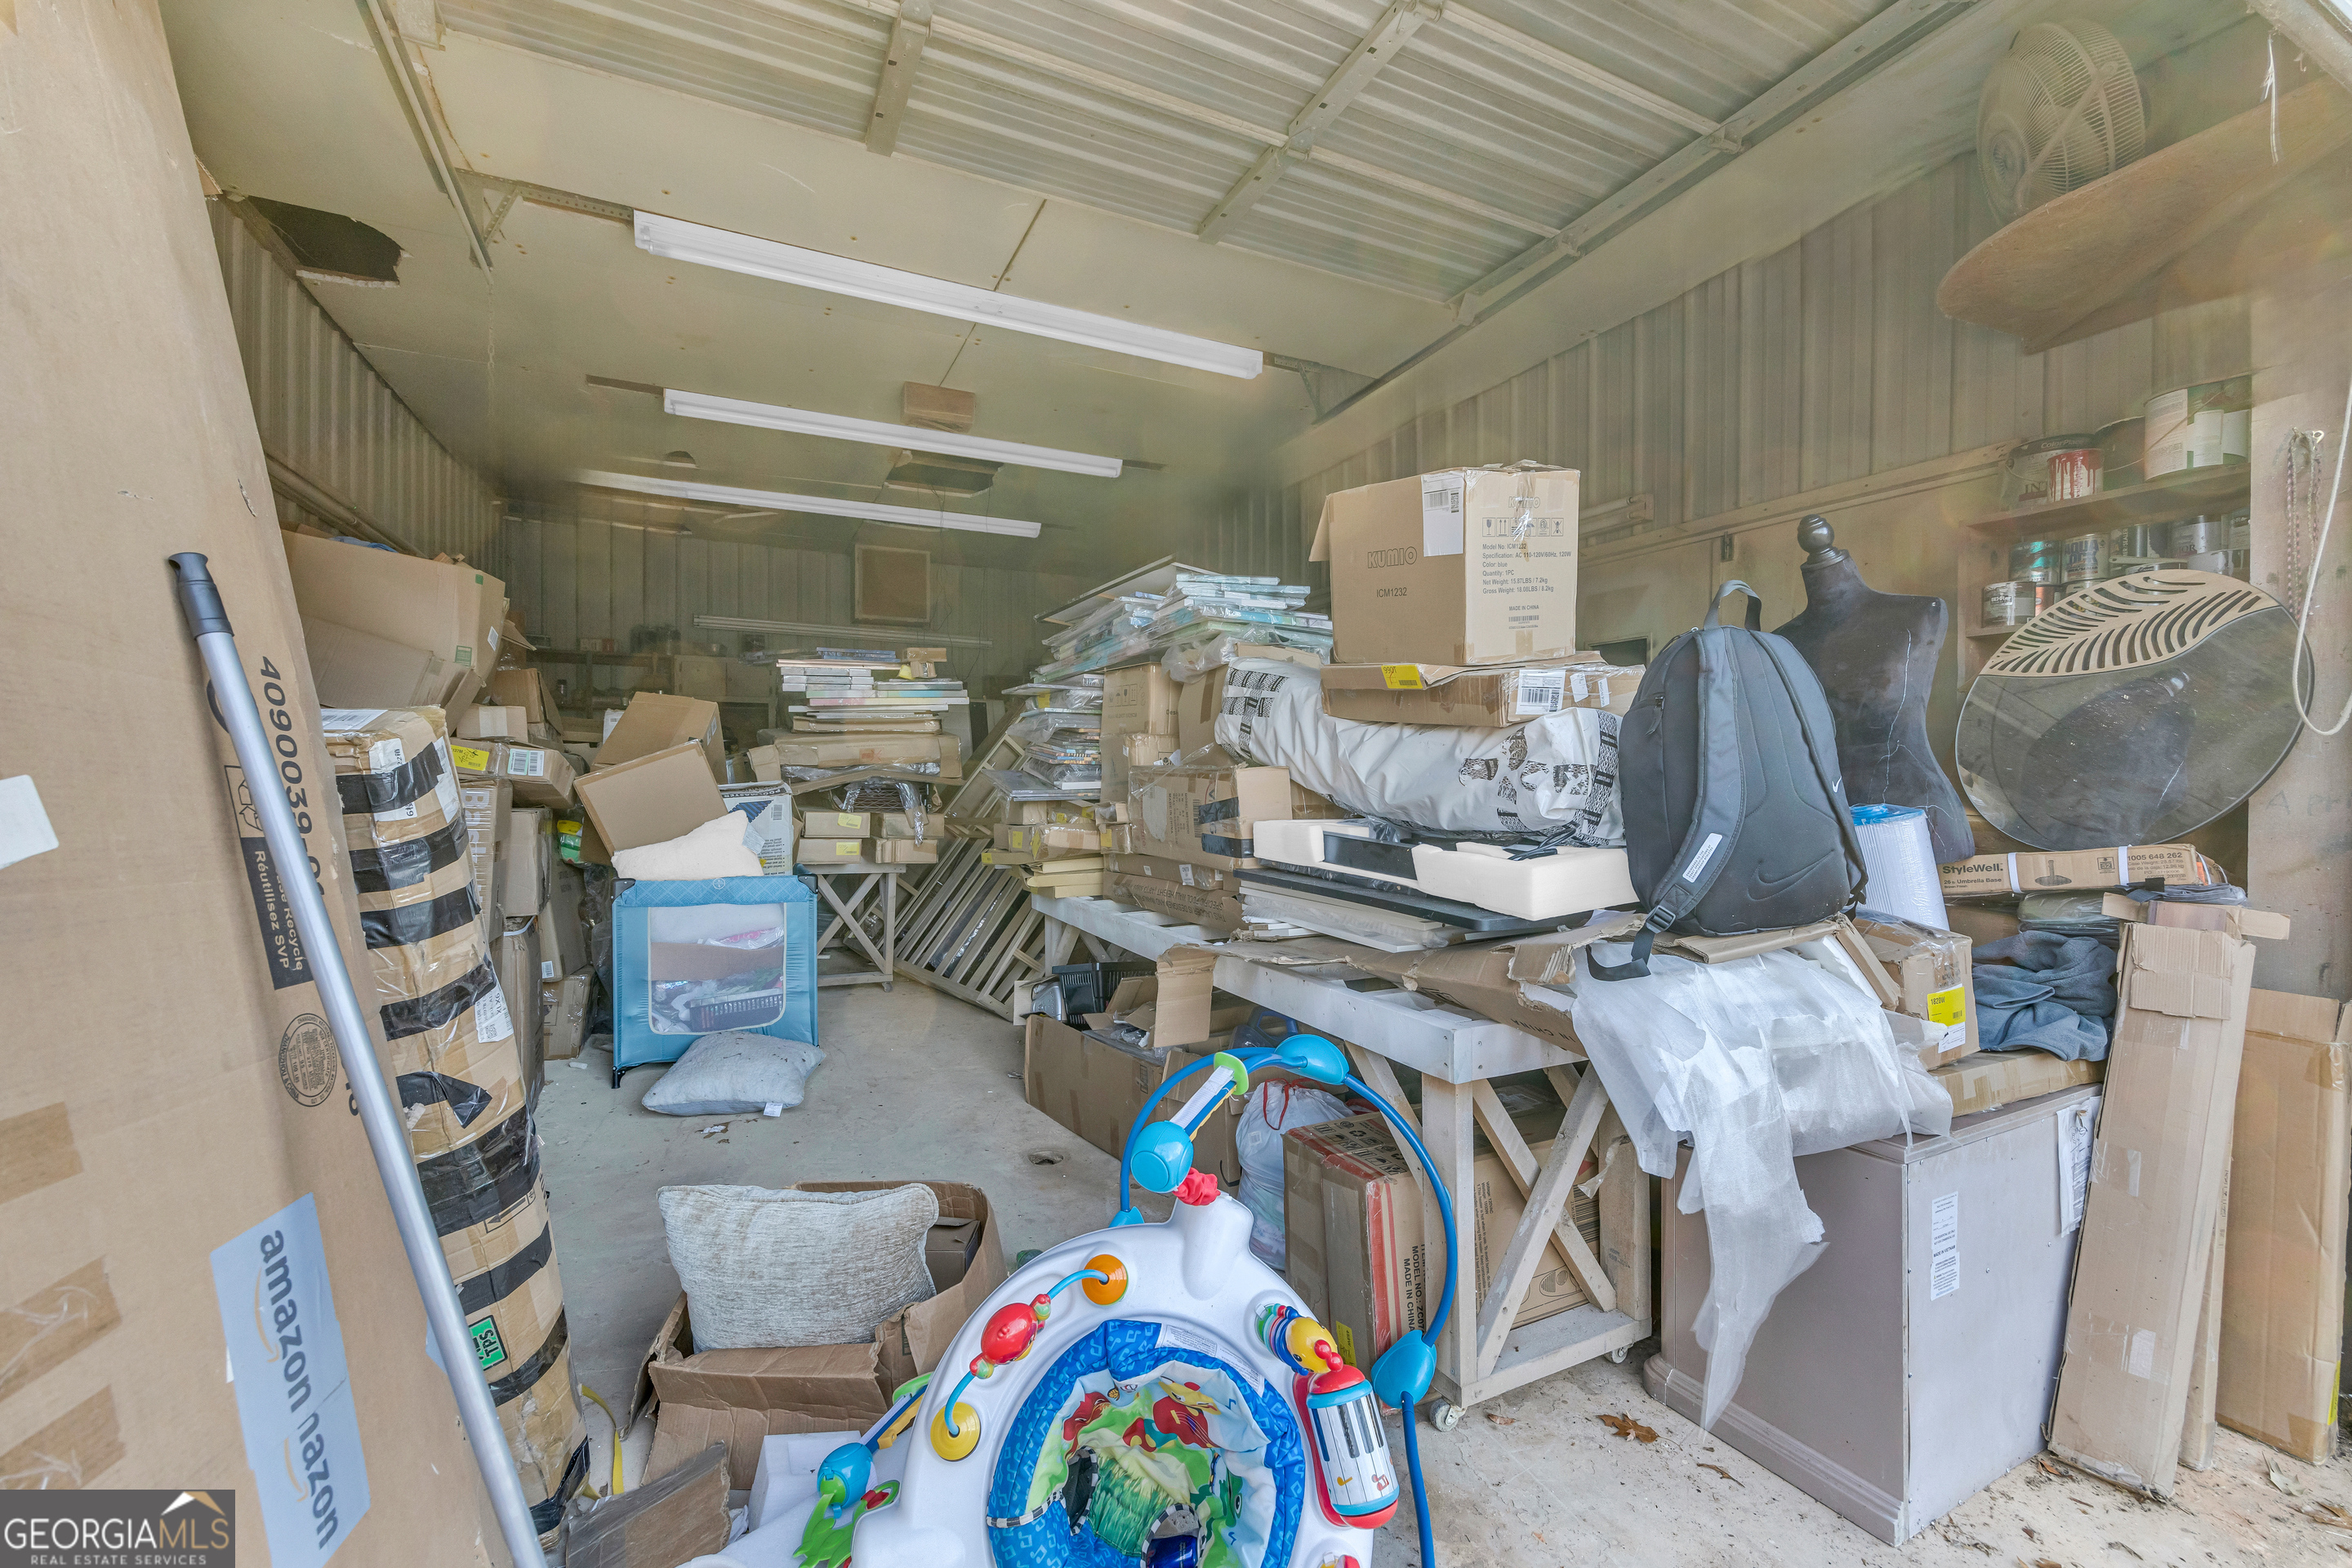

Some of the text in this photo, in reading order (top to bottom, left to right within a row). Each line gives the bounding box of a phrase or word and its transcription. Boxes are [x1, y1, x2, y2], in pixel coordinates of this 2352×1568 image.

[2041, 439, 2084, 448] ColorPlace
[1367, 546, 1418, 568] KUMIO
[1376, 587, 1407, 598] ICM1232
[254, 849, 281, 930] Réutilisez
[1192, 907, 1214, 920] LADDER
[1213, 912, 1227, 923] THIS
[283, 902, 305, 972] Recycle
[273, 934, 291, 969] SVP
[1931, 996, 1946, 1005] 1820W
[1944, 1245, 1956, 1253] VIETNAM
[1411, 1245, 1422, 1281] MODEL
[1403, 1258, 1416, 1332] MADE IN CHINA
[260, 1230, 312, 1413] amazon
